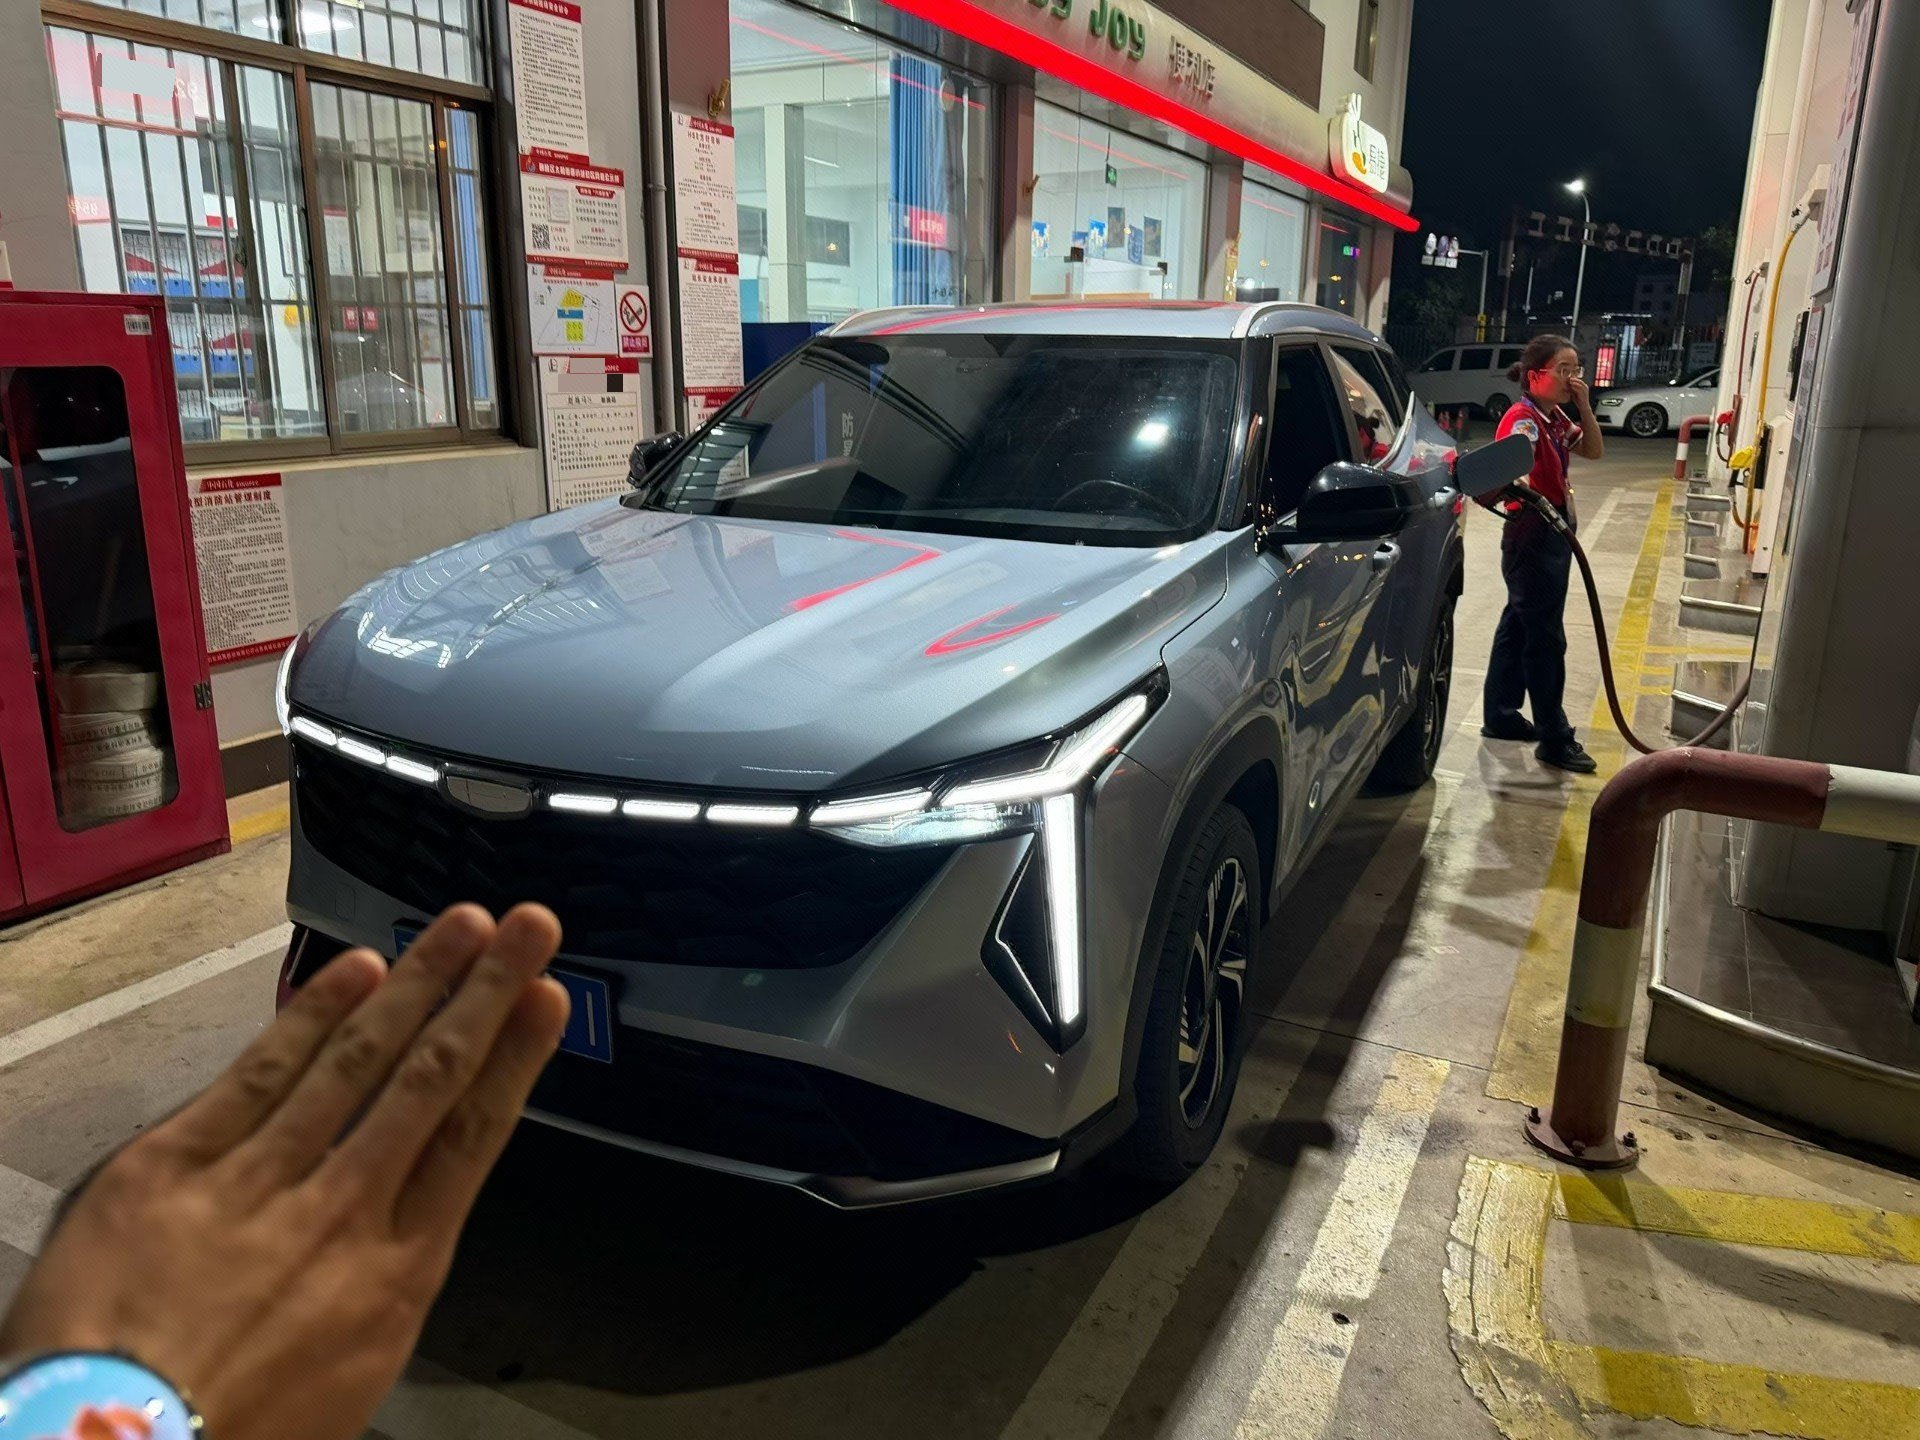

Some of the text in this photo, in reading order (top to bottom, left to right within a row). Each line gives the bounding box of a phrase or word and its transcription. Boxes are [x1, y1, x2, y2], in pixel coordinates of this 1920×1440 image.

[1168, 35, 1217, 95] 便利店
[189, 490, 272, 508] 型消防站管理制度
